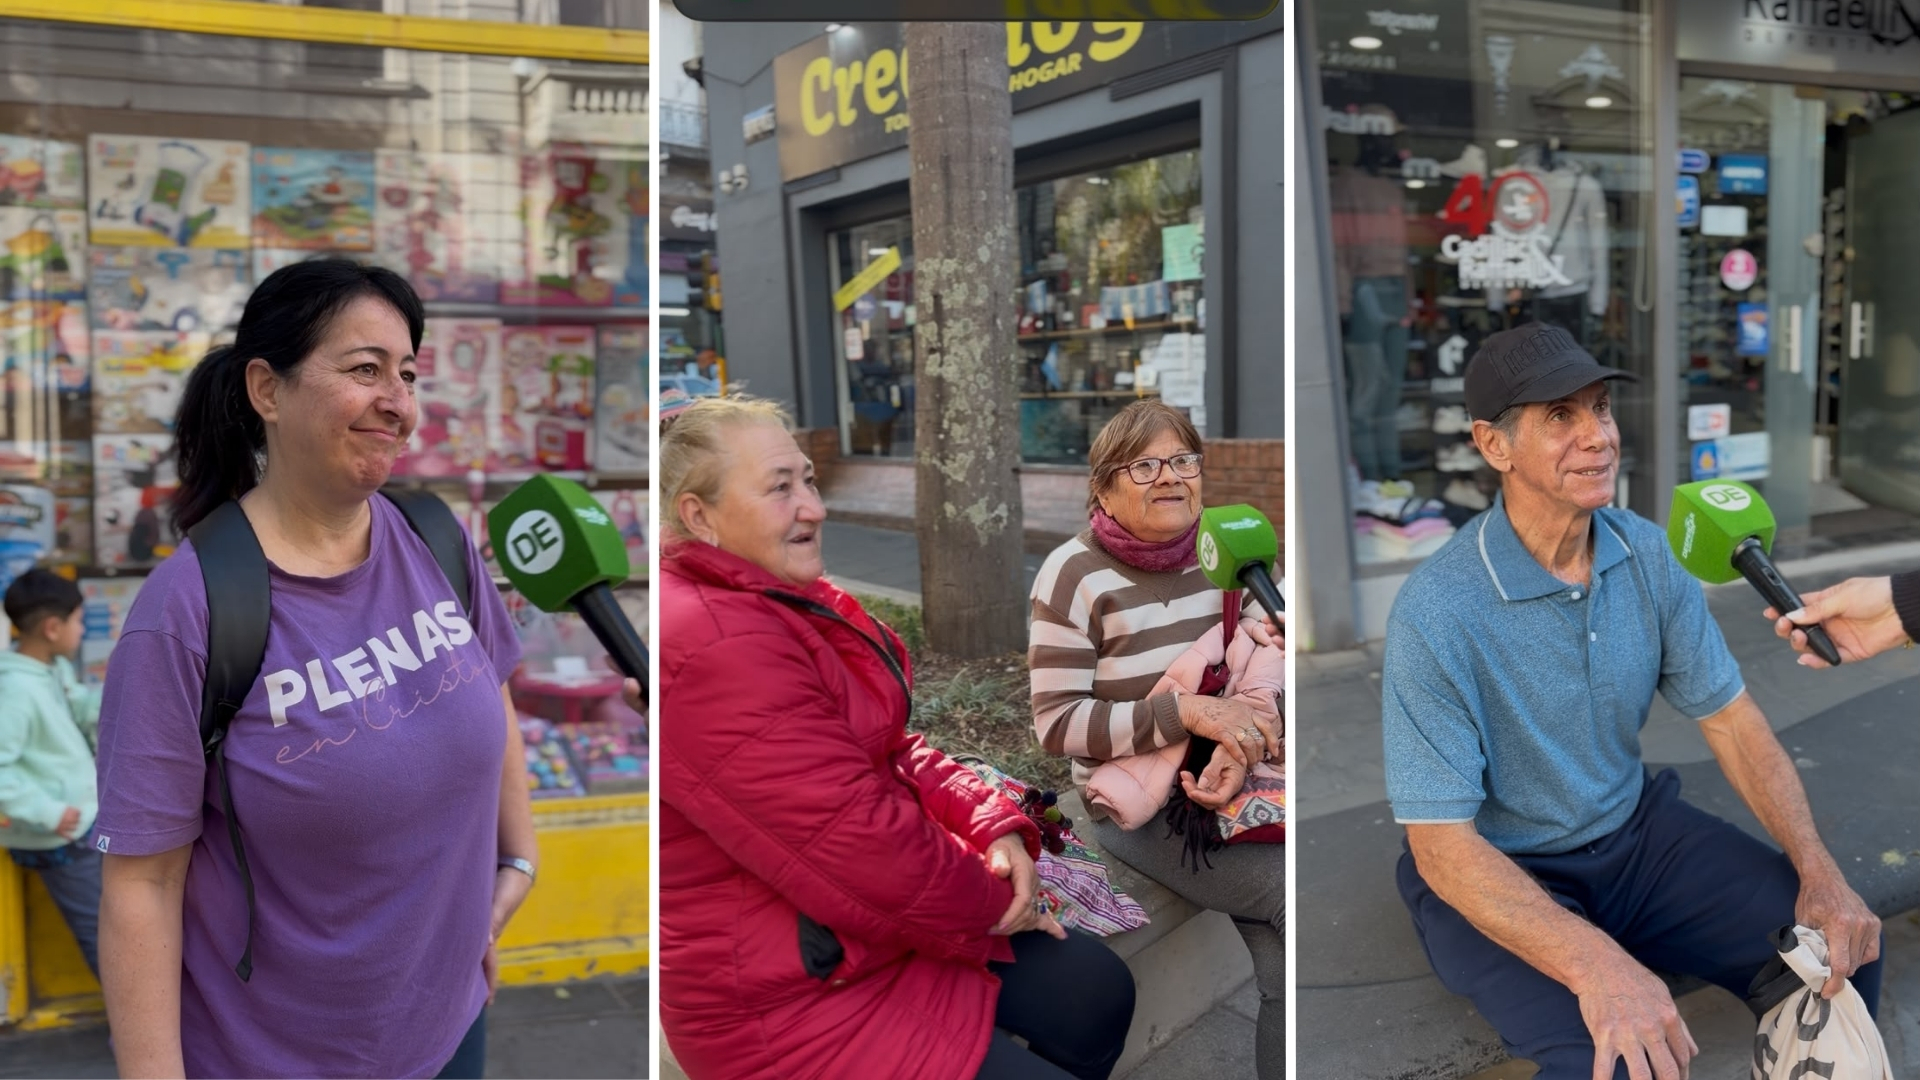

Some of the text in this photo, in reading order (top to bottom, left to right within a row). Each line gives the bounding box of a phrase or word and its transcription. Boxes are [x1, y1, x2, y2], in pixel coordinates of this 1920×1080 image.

[1009, 52, 1083, 93] HOGAR
[1706, 487, 1748, 505] DE
[511, 517, 559, 565] DE
[1203, 535, 1214, 567] DE
[263, 600, 472, 728] PLENAS
[275, 728, 356, 764] en
